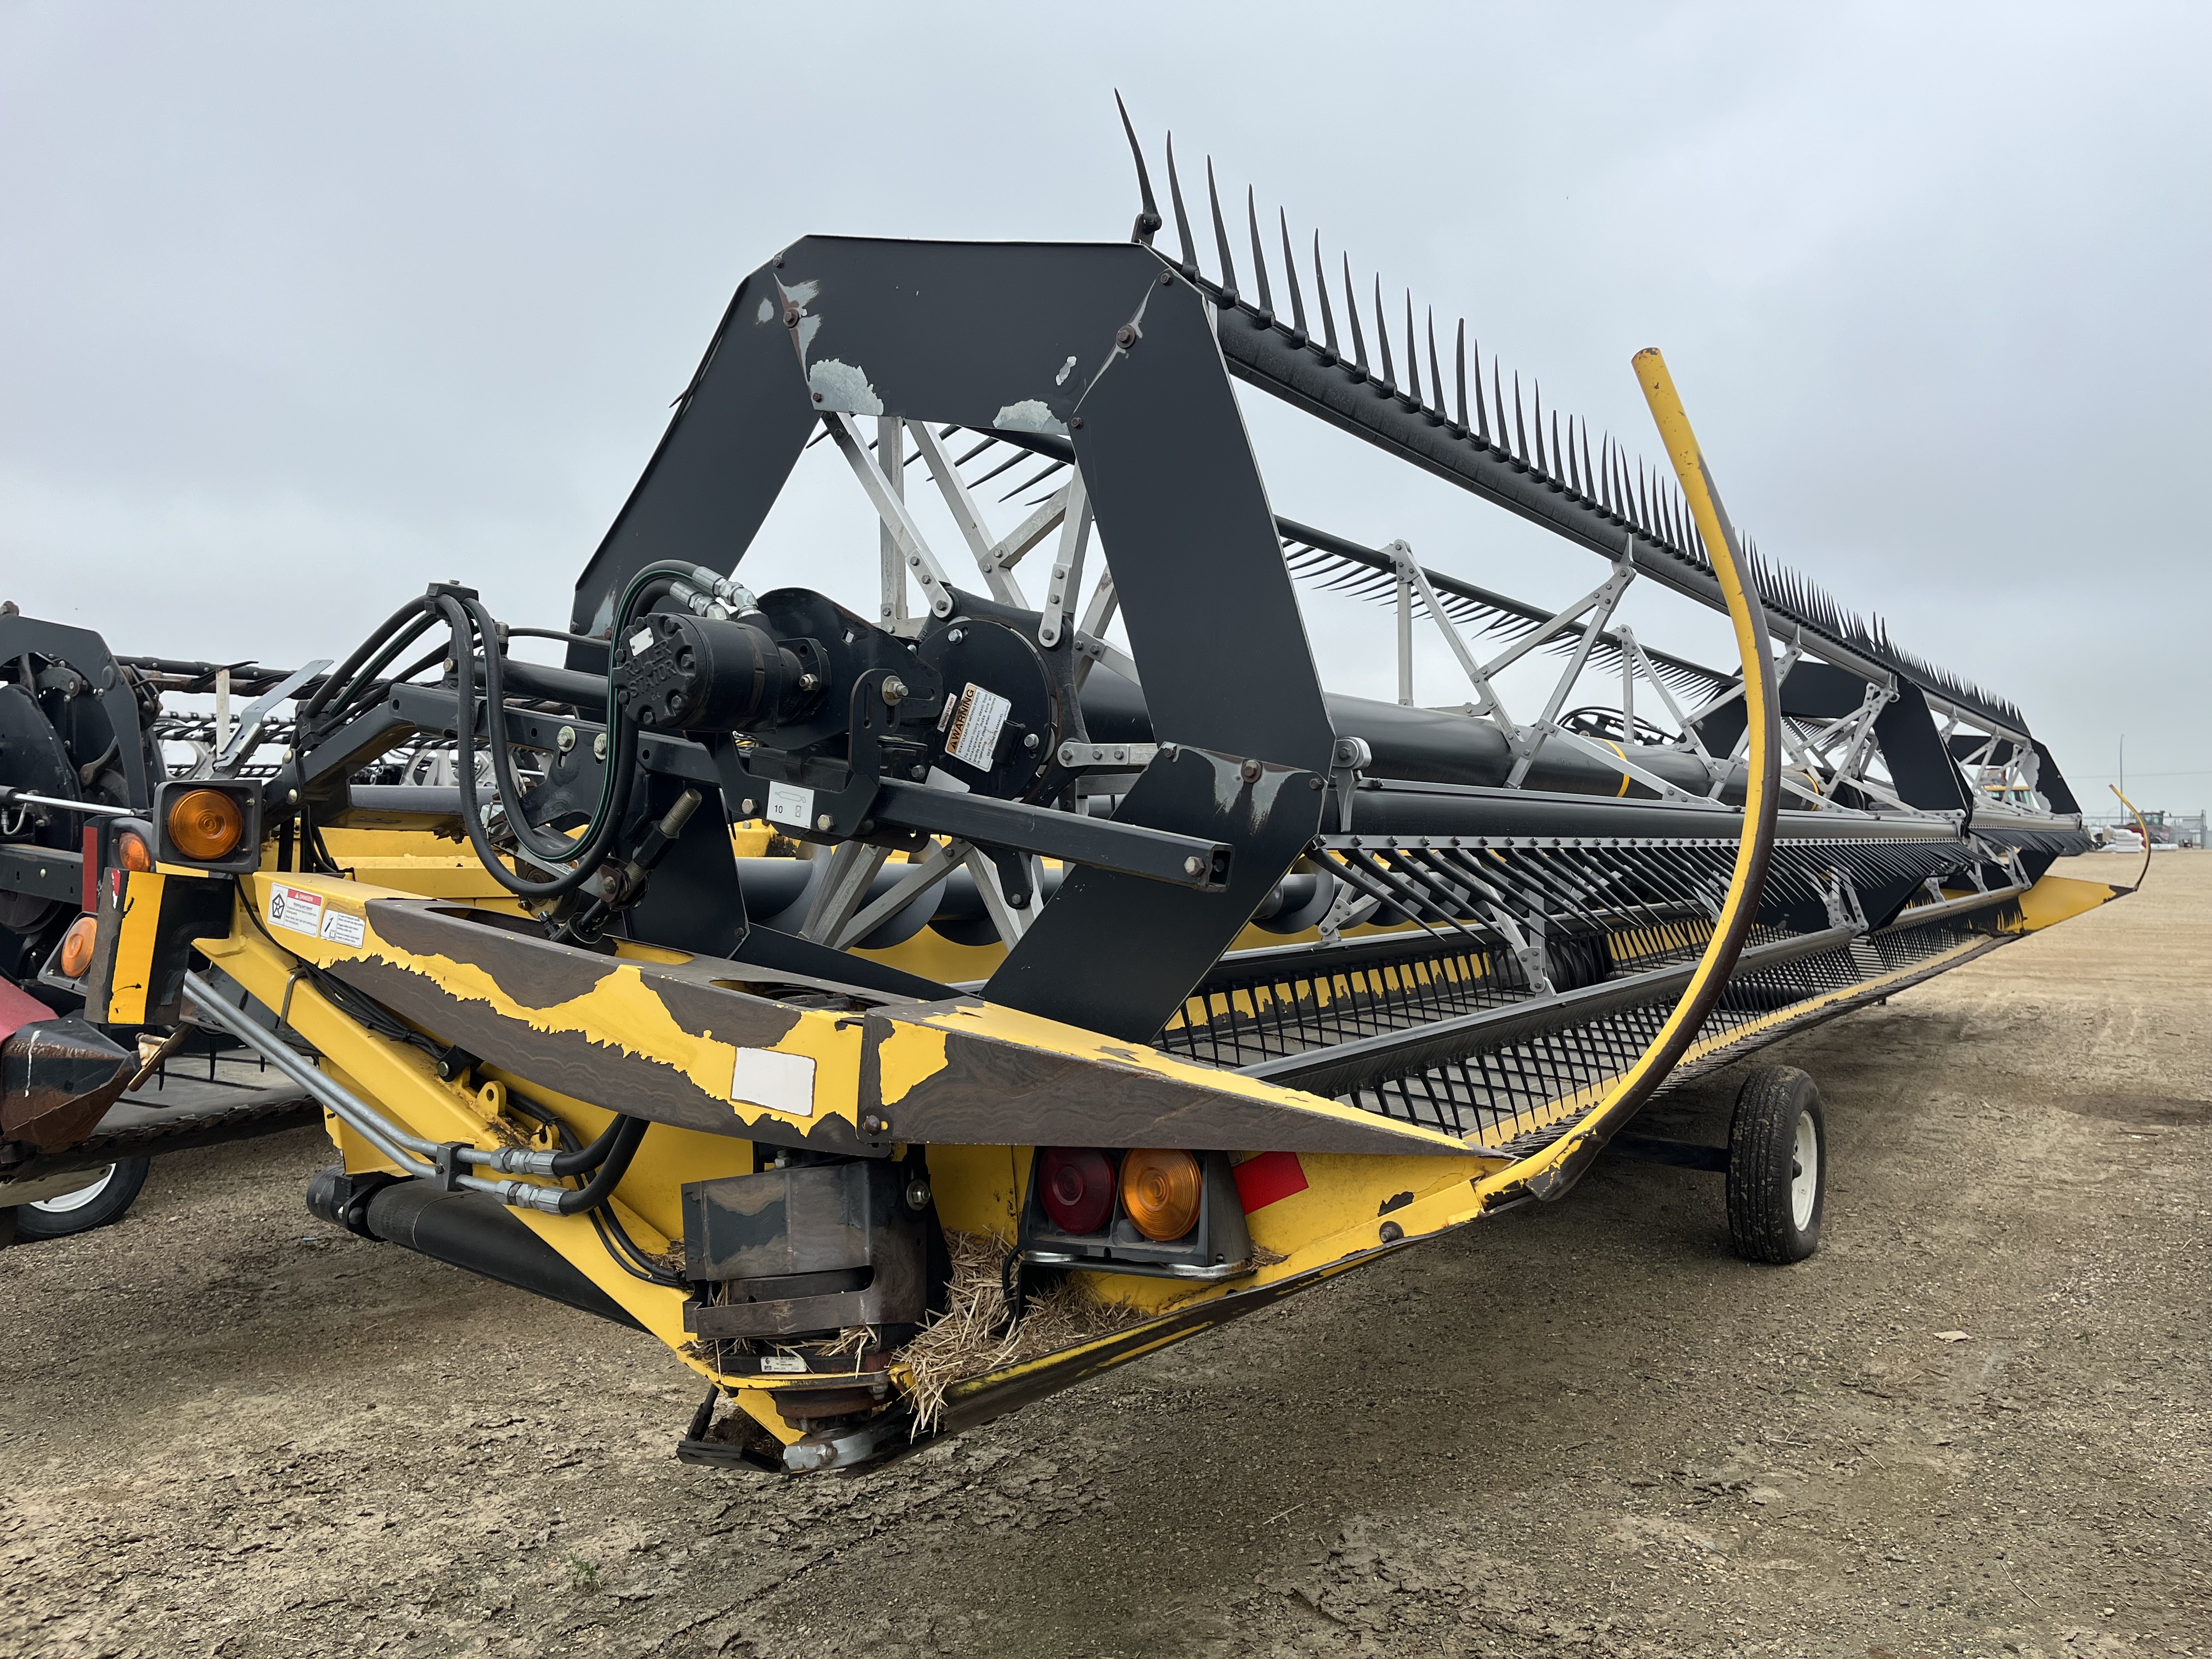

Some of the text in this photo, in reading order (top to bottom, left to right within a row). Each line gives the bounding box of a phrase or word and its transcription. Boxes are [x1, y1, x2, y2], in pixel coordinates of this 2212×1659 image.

[629, 659, 678, 699] STATOR
[951, 689, 974, 741] WARNING
[968, 705, 976, 722] MOVING
[995, 712, 1003, 730] MANUAL
[966, 735, 975, 752] prevent
[775, 805, 783, 814] 10
[298, 893, 313, 902] DANGER
